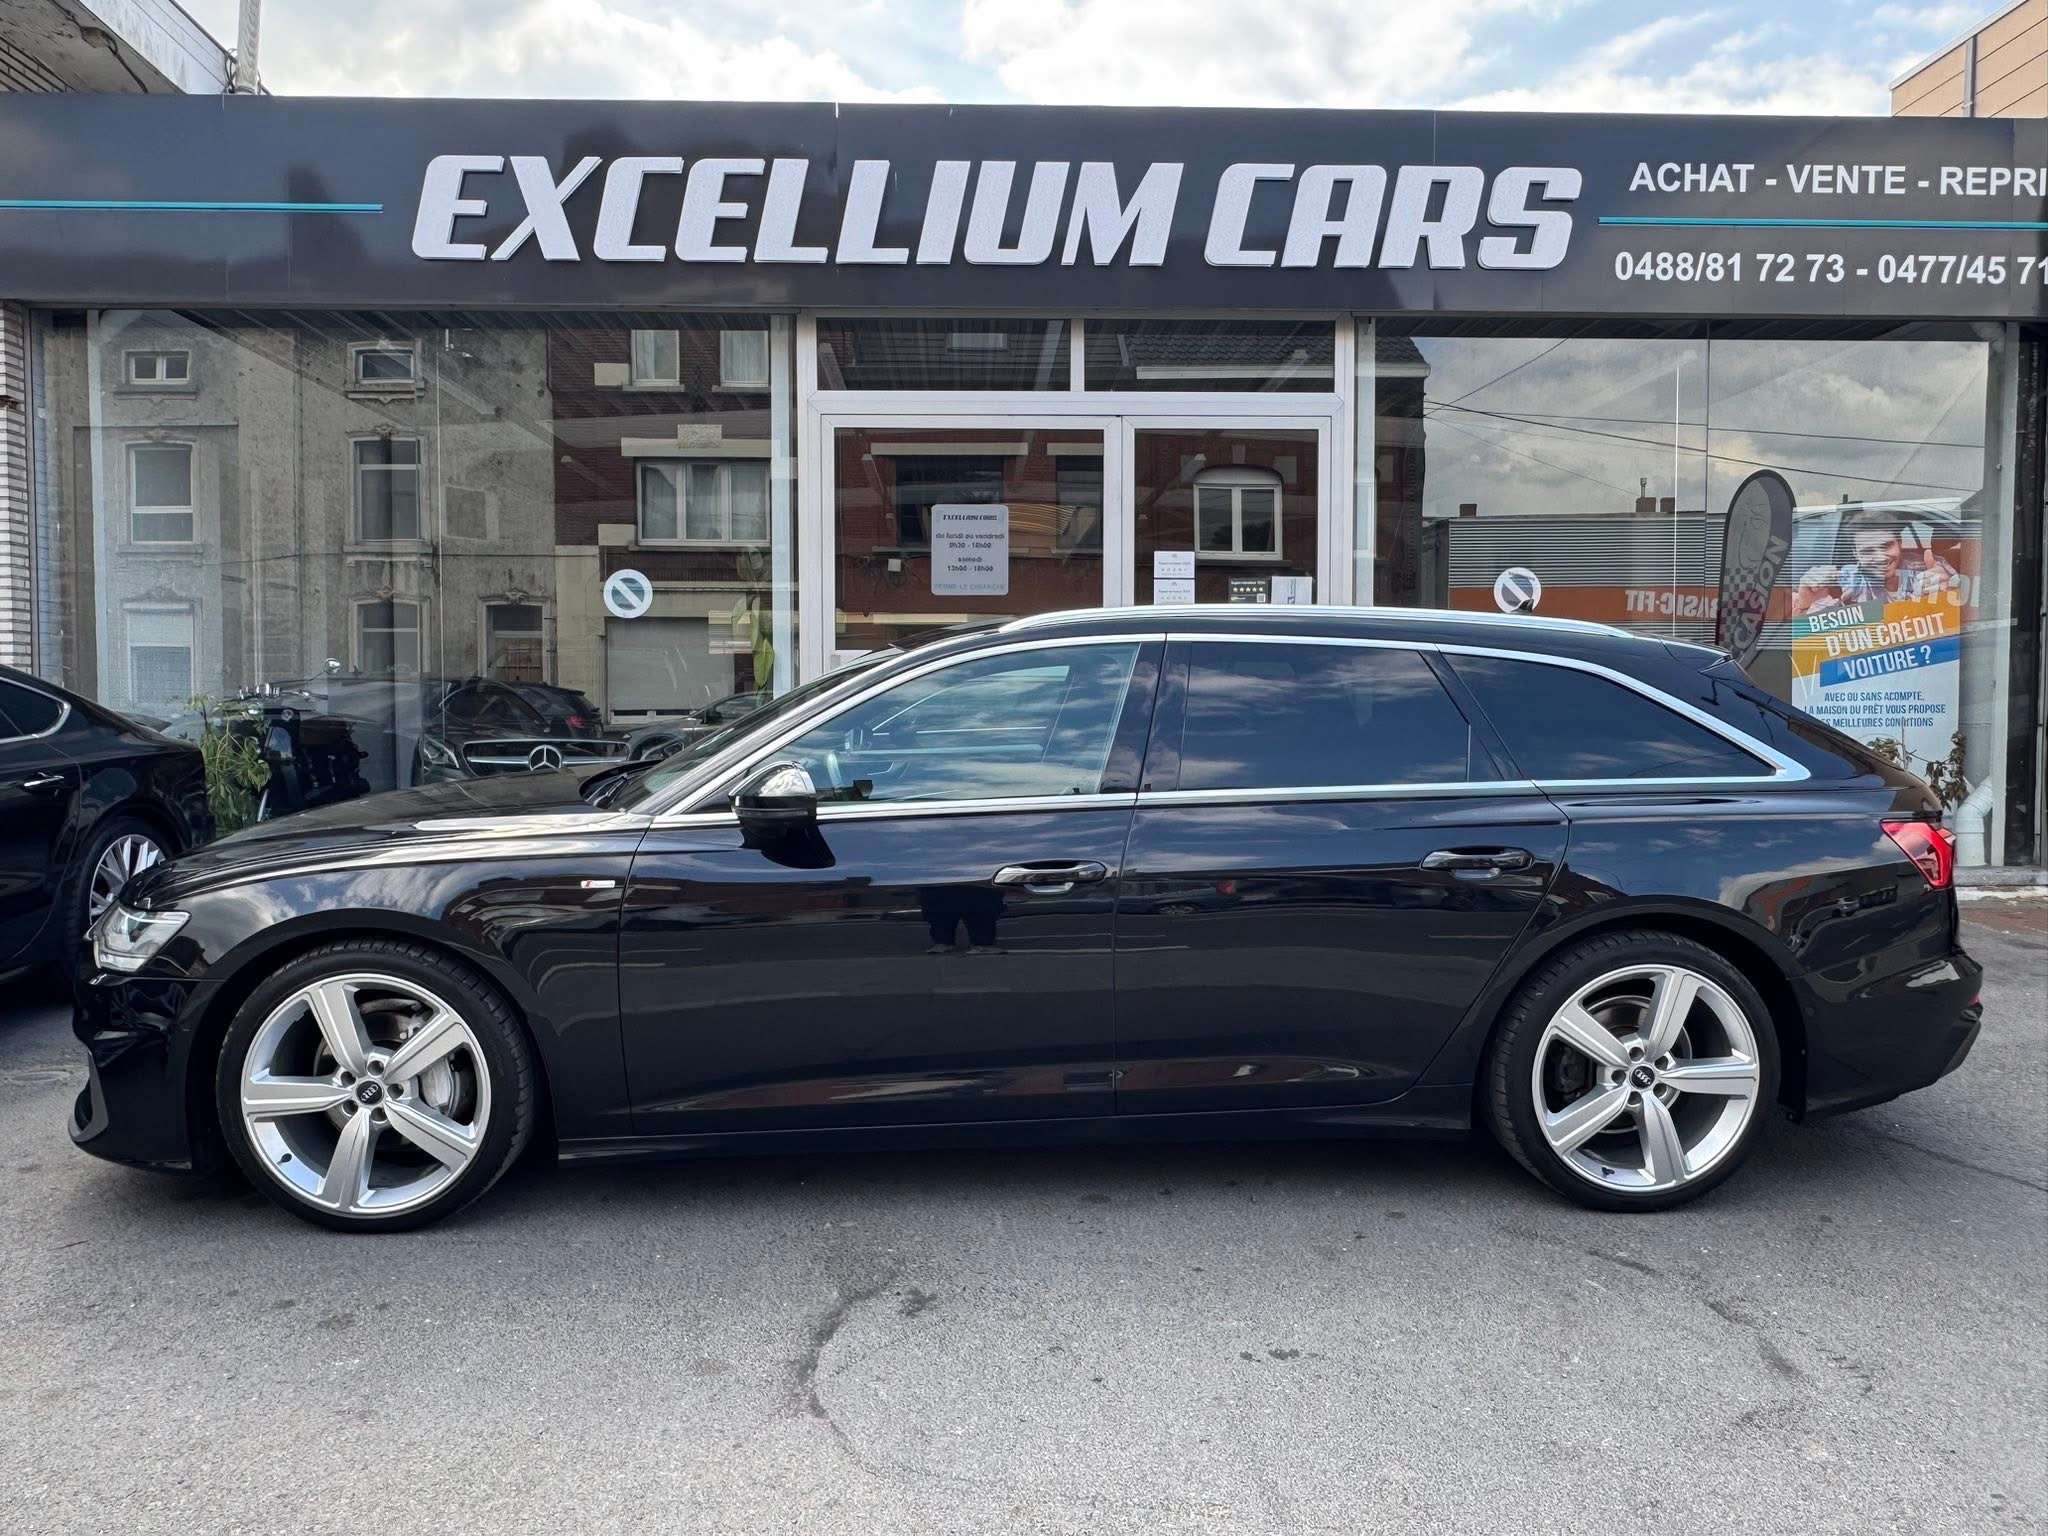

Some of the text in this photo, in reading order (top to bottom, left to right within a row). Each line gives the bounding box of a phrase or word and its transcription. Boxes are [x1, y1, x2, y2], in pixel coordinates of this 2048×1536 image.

[1629, 162, 1755, 193] ACHAT
[1786, 164, 1906, 194] VENTE
[1939, 166, 2048, 197] REPRI
[411, 154, 1583, 270] EXCELLIUM CARS
[1614, 251, 1741, 282] 0488/81
[1756, 253, 1795, 282] 72
[1806, 253, 1845, 284] 73
[1877, 254, 2006, 285] 0477/45
[1808, 606, 1865, 632] BESOIN
[1825, 612, 1944, 657] D'UN CRÉDIT
[1843, 644, 1932, 679] VOITURE ?
[1816, 705, 1848, 714] MAISON
[1850, 705, 1861, 714] DU
[1863, 703, 1883, 714] PRÊT
[1885, 705, 1906, 714] VOUS
[1908, 704, 1946, 714] PROPOSE
[1824, 692, 1846, 701] AVEC
[1847, 692, 1858, 701] OU
[1860, 692, 1882, 701] SANS
[1833, 718, 1884, 728] MEILLEURES
